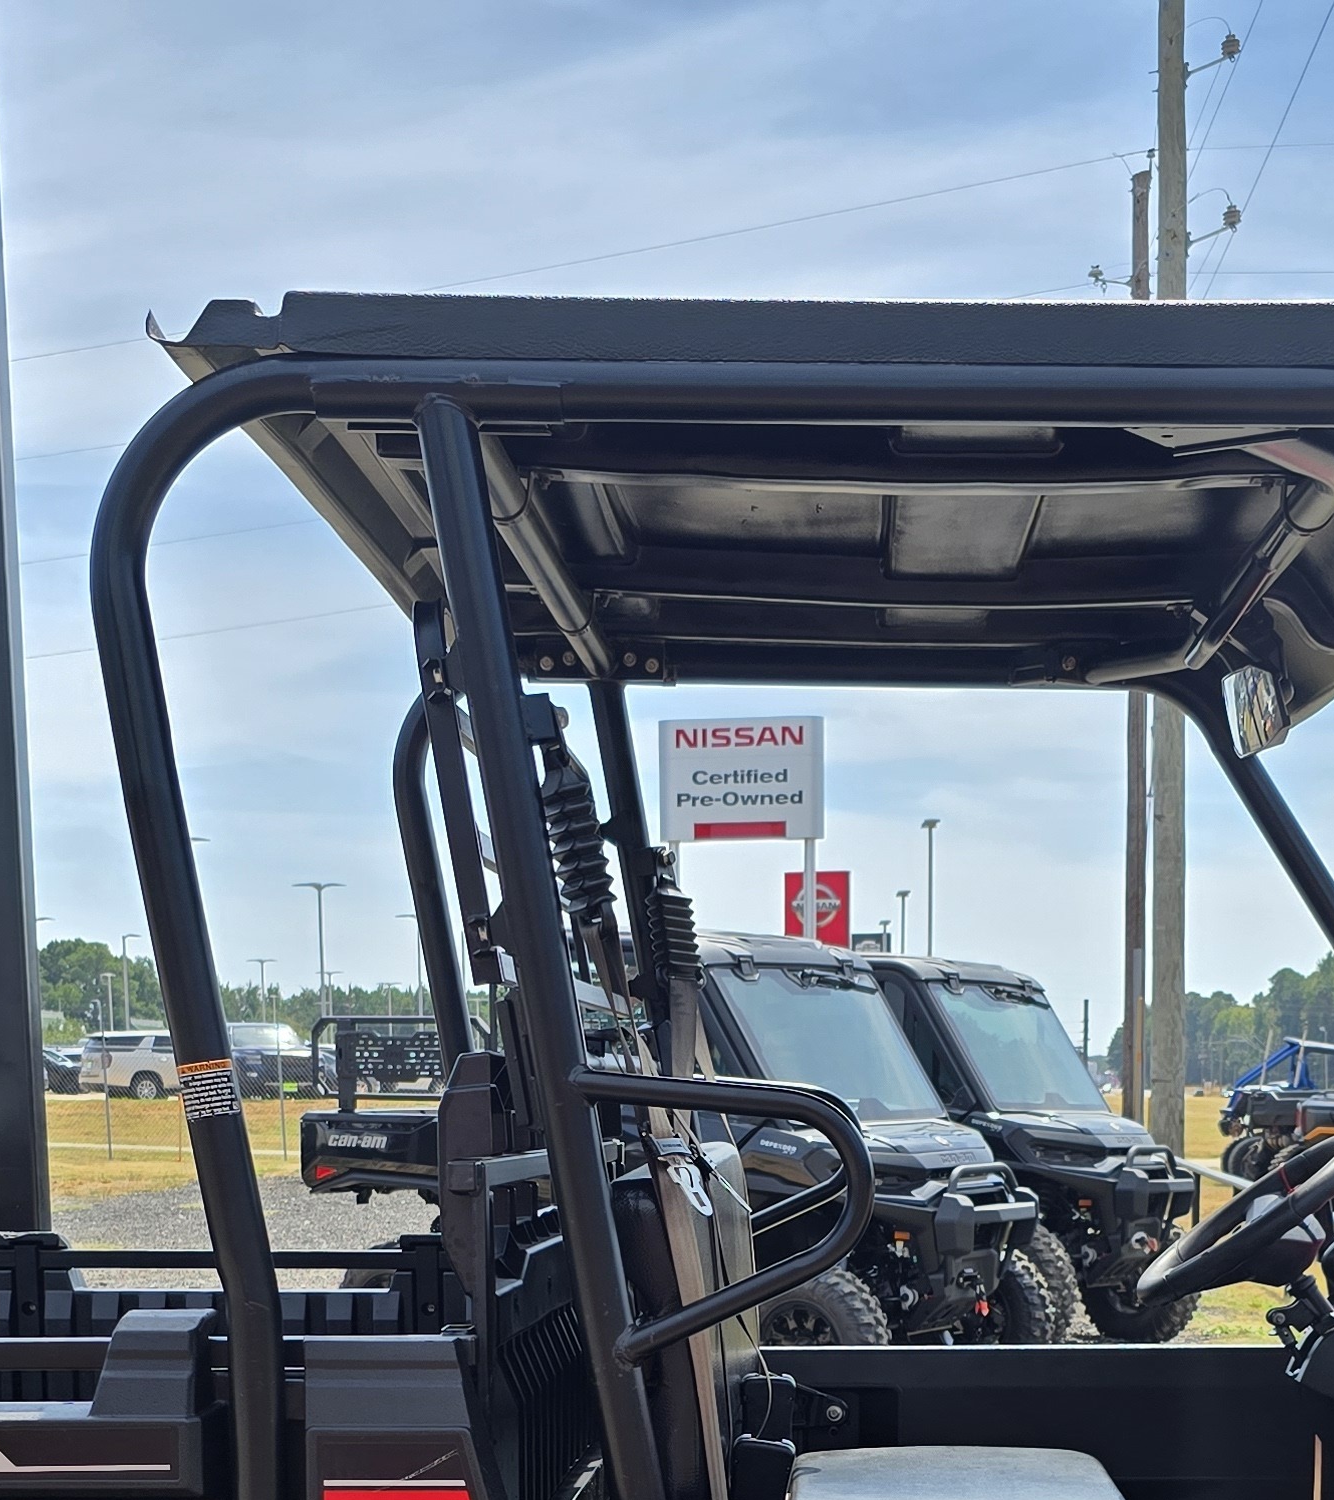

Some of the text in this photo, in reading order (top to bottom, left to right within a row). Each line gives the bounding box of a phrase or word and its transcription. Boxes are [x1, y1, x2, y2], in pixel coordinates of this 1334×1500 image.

[675, 726, 805, 749] NISSAN
[691, 768, 789, 786] Certified
[676, 790, 804, 808] Pre-Owned
[188, 1062, 228, 1073] WARNING
[327, 1134, 388, 1149] can-am
